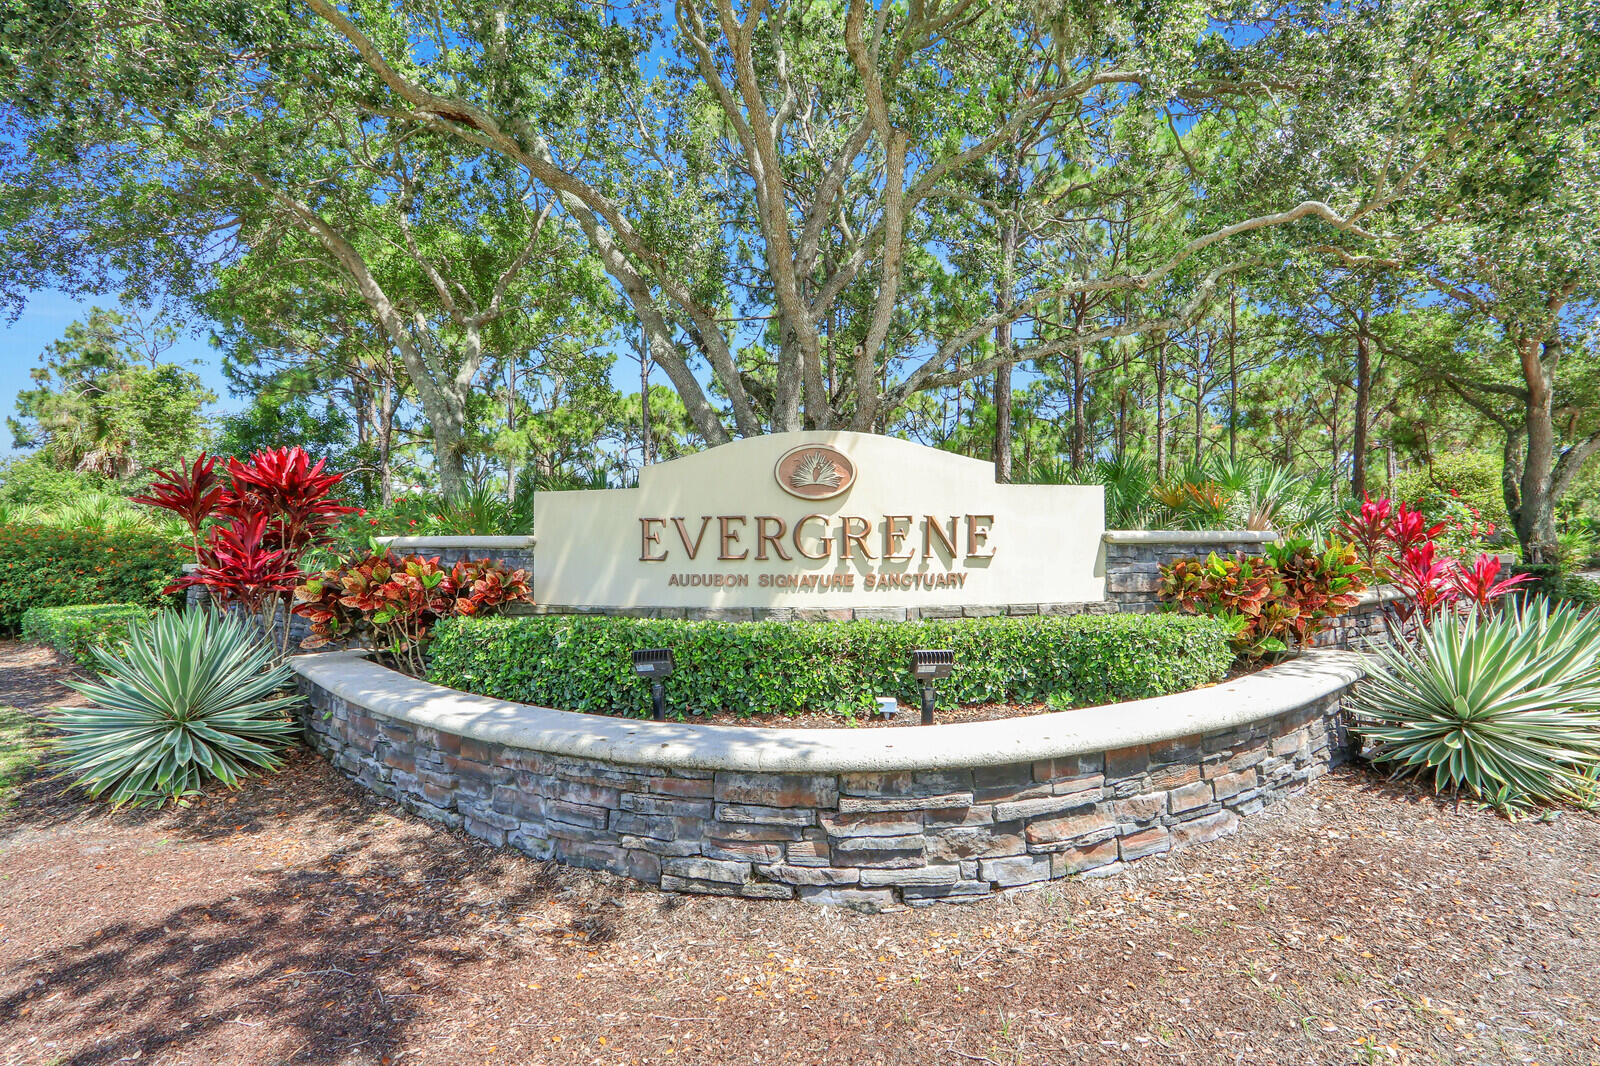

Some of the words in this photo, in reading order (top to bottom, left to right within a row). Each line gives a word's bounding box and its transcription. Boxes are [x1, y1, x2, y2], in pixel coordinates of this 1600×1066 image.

[638, 514, 997, 561] EVERGRENE
[668, 573, 749, 587] AUDUBON
[758, 573, 854, 587] SIGNATURE
[865, 572, 968, 587] SANCTUARY
